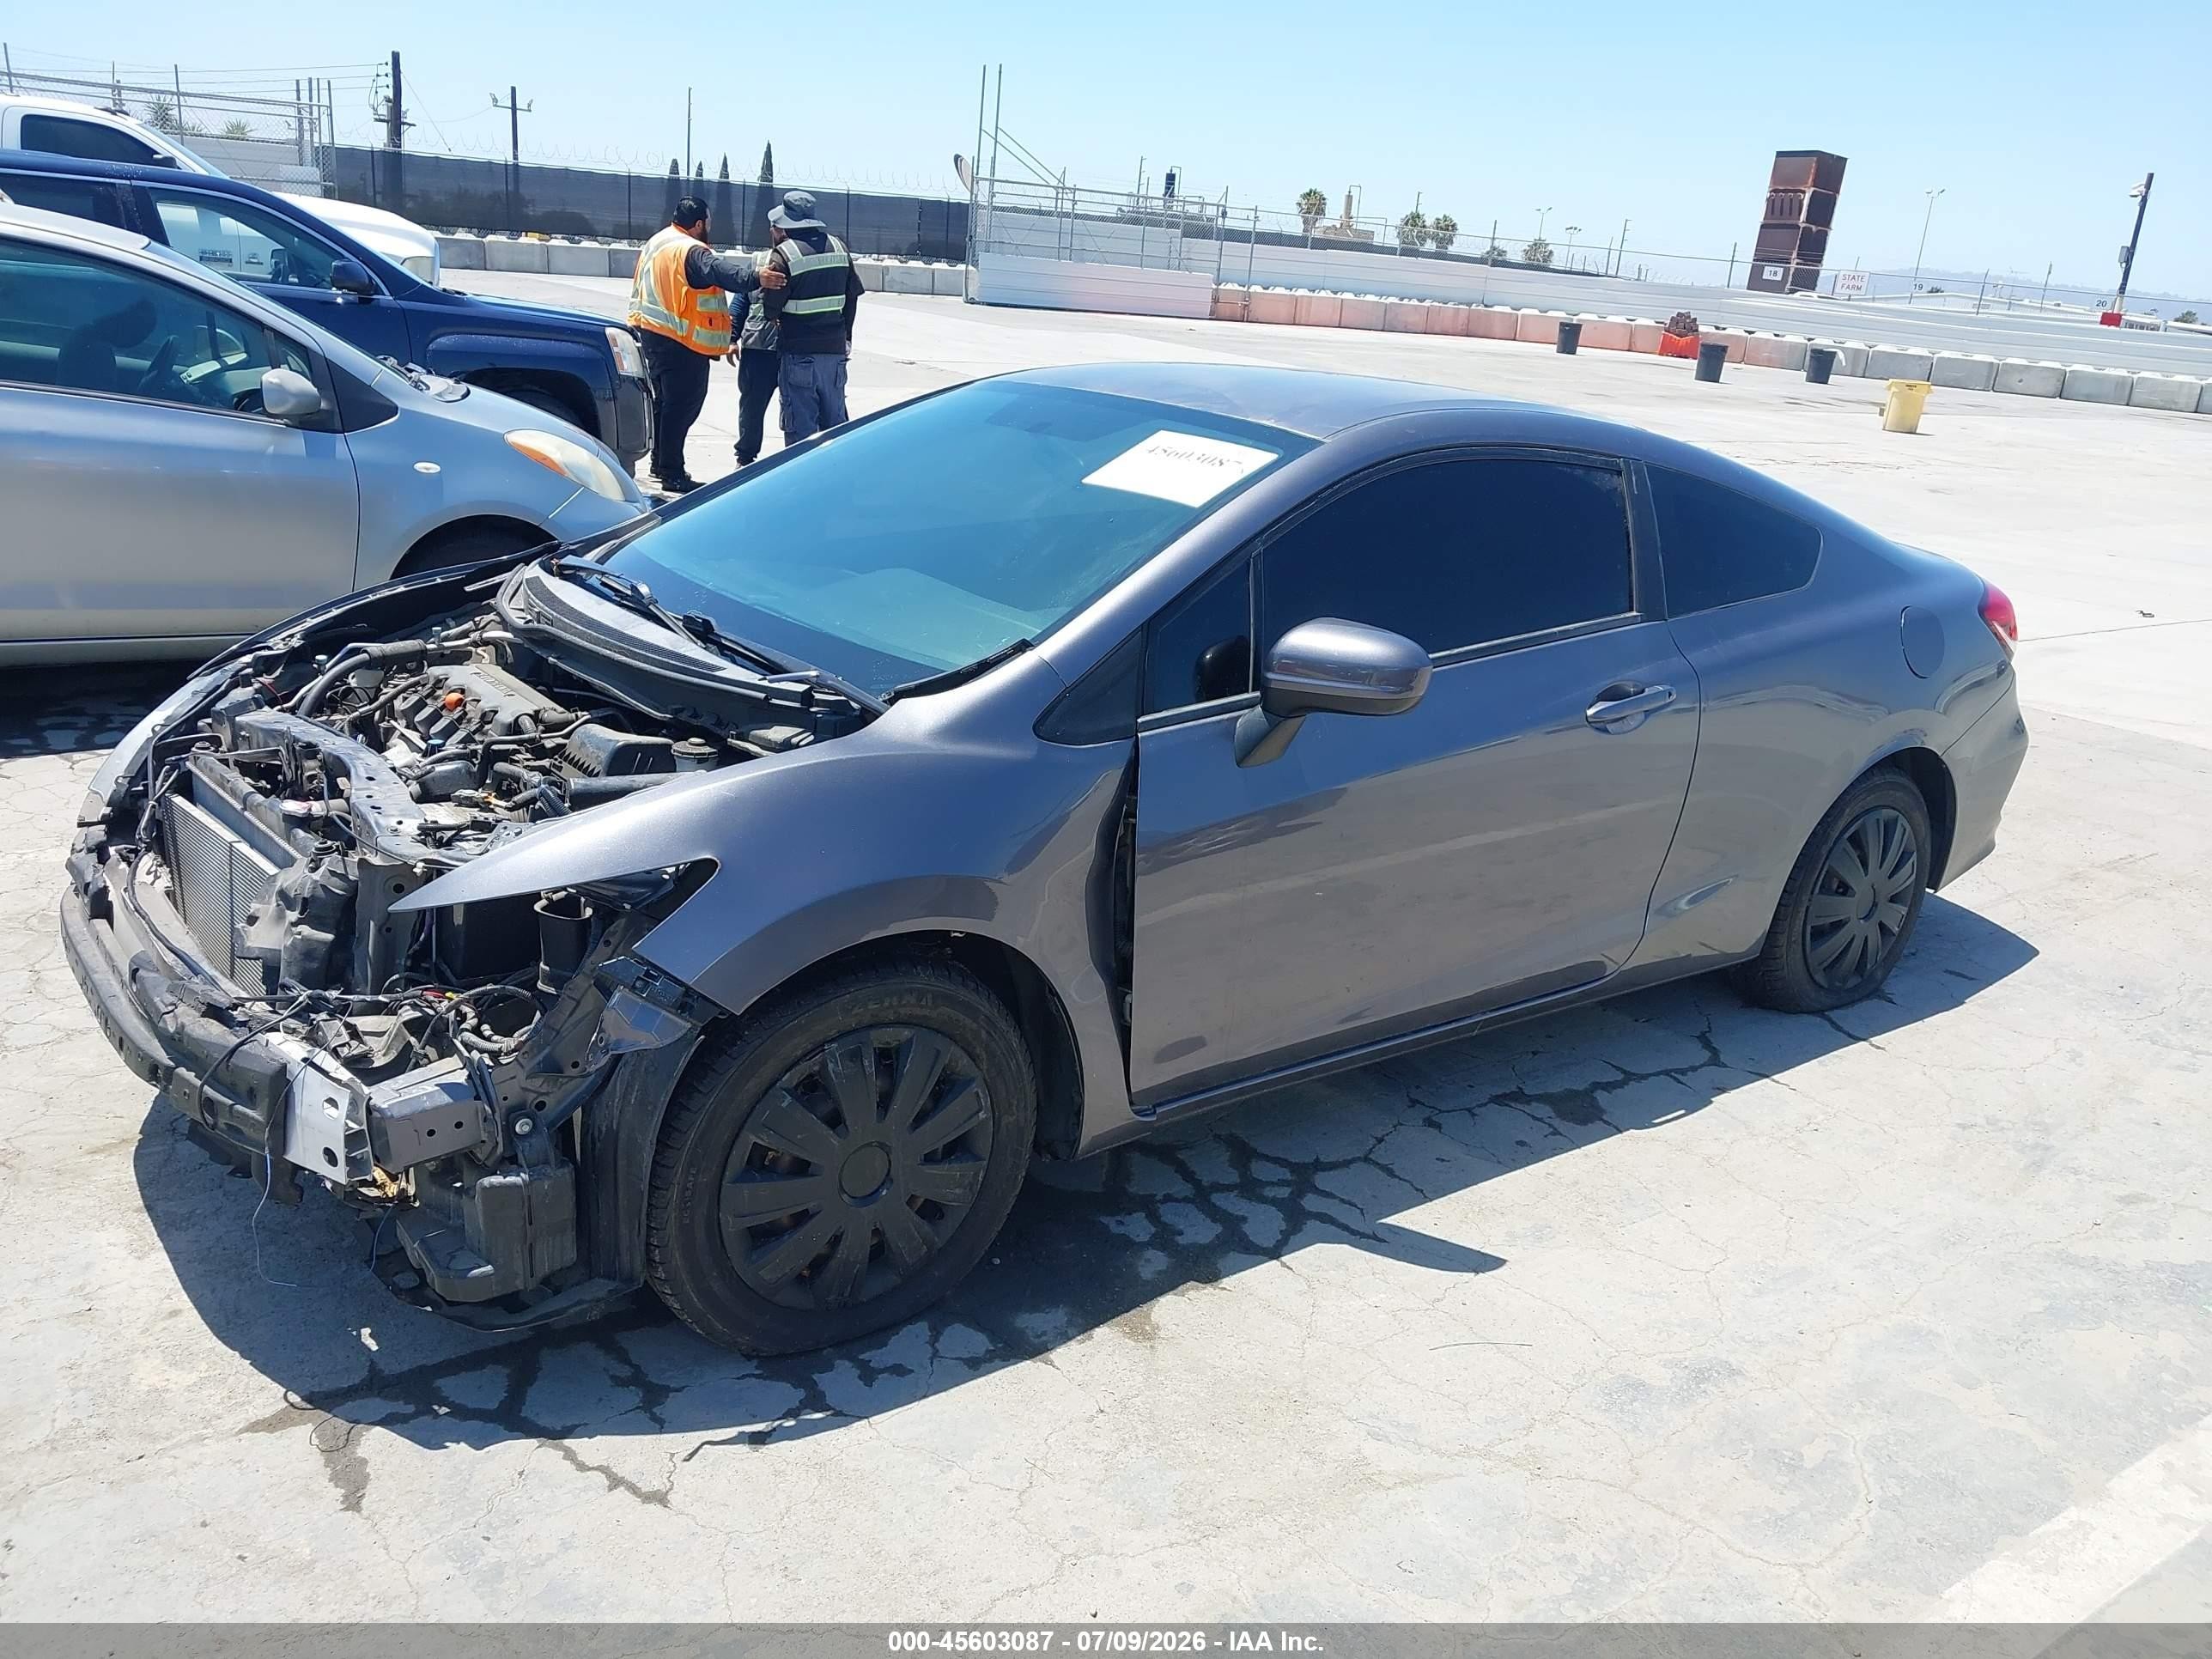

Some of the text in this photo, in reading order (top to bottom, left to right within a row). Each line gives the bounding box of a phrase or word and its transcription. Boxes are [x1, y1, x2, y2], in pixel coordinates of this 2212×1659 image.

[1841, 274, 1866, 283] STATE
[1840, 283, 1863, 292] FARM
[1912, 283, 1923, 291] 19
